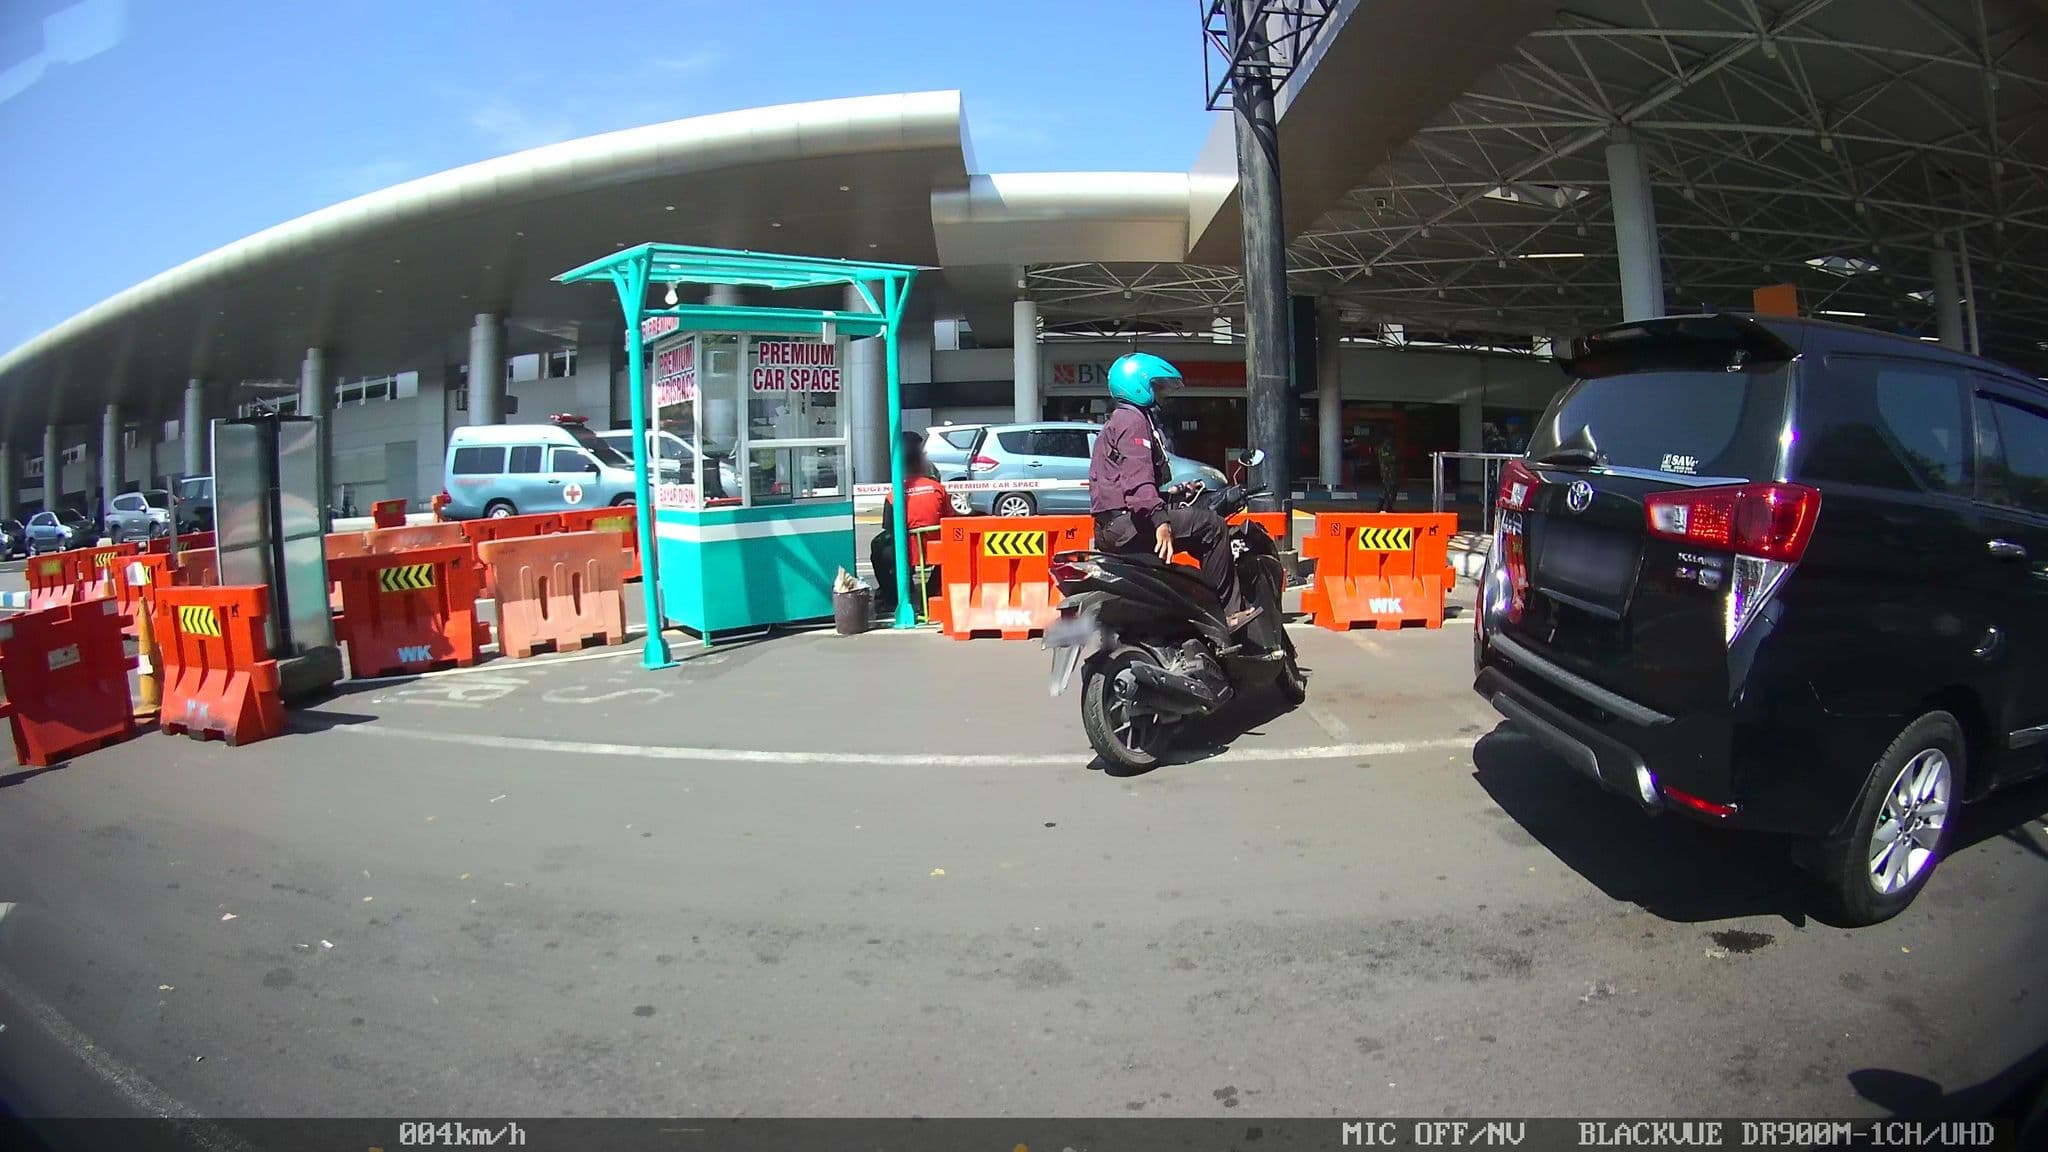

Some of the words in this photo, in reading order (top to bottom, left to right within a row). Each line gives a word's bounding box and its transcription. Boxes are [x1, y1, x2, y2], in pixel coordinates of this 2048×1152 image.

[659, 341, 694, 377] PREMIUM
[759, 341, 835, 366] PREMIUM
[753, 368, 785, 391] CAR
[790, 368, 840, 391] SPACE
[1369, 597, 1403, 614] WK
[995, 609, 1033, 626] WK
[397, 645, 434, 662] WK
